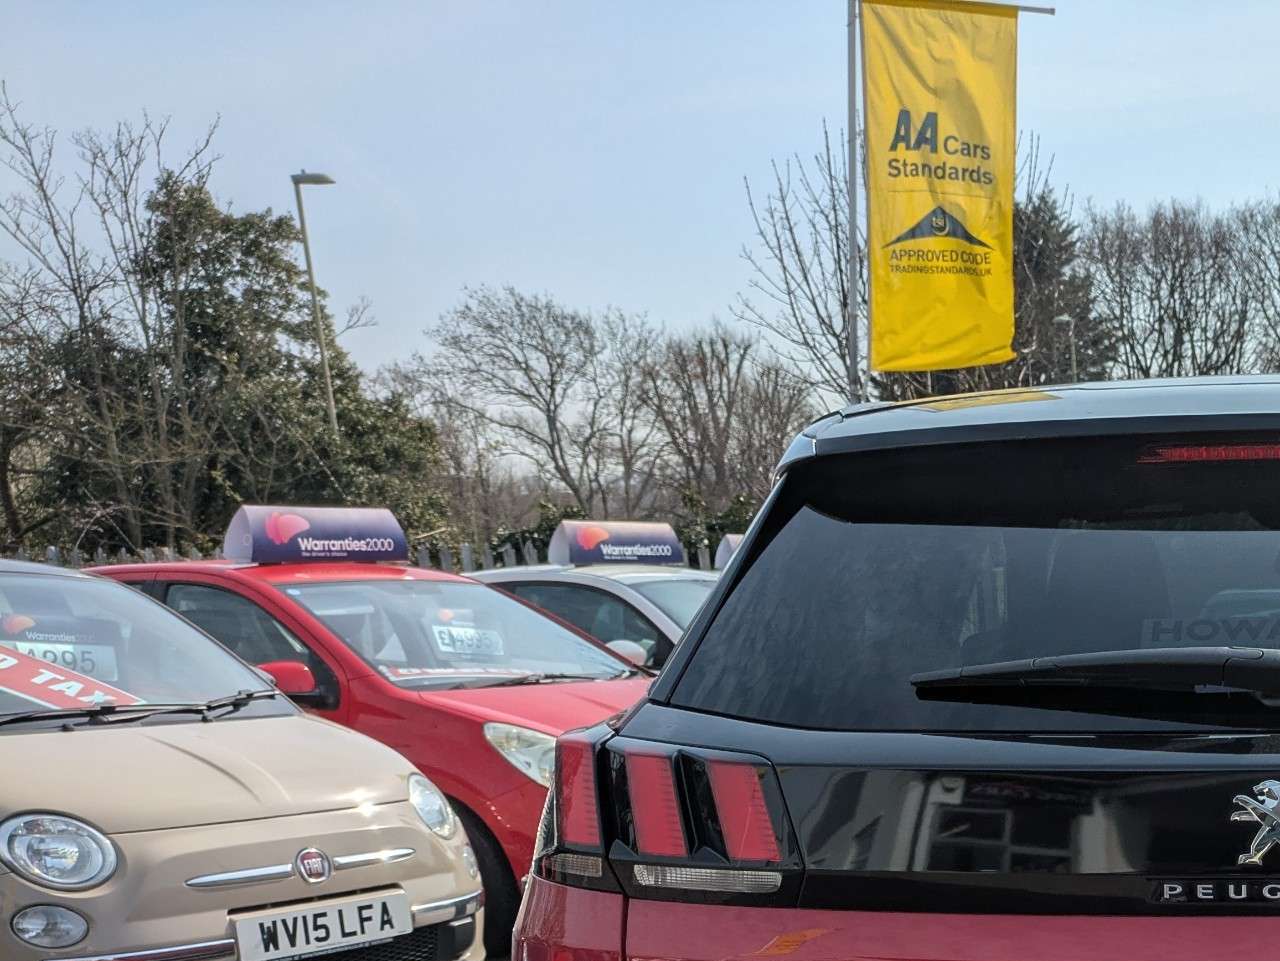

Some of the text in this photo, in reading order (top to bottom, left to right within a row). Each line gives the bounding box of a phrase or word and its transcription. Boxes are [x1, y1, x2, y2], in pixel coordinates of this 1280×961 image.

[888, 107, 991, 160] AA Cars
[887, 158, 993, 185] Standards
[889, 249, 991, 265] APPROVED CODE
[298, 537, 394, 552] Warranties2000
[600, 543, 672, 556] Warranties2000
[31, 668, 118, 707] TAX
[304, 857, 323, 874] FIAT
[259, 912, 330, 953] WV15
[338, 901, 394, 938] LFA
